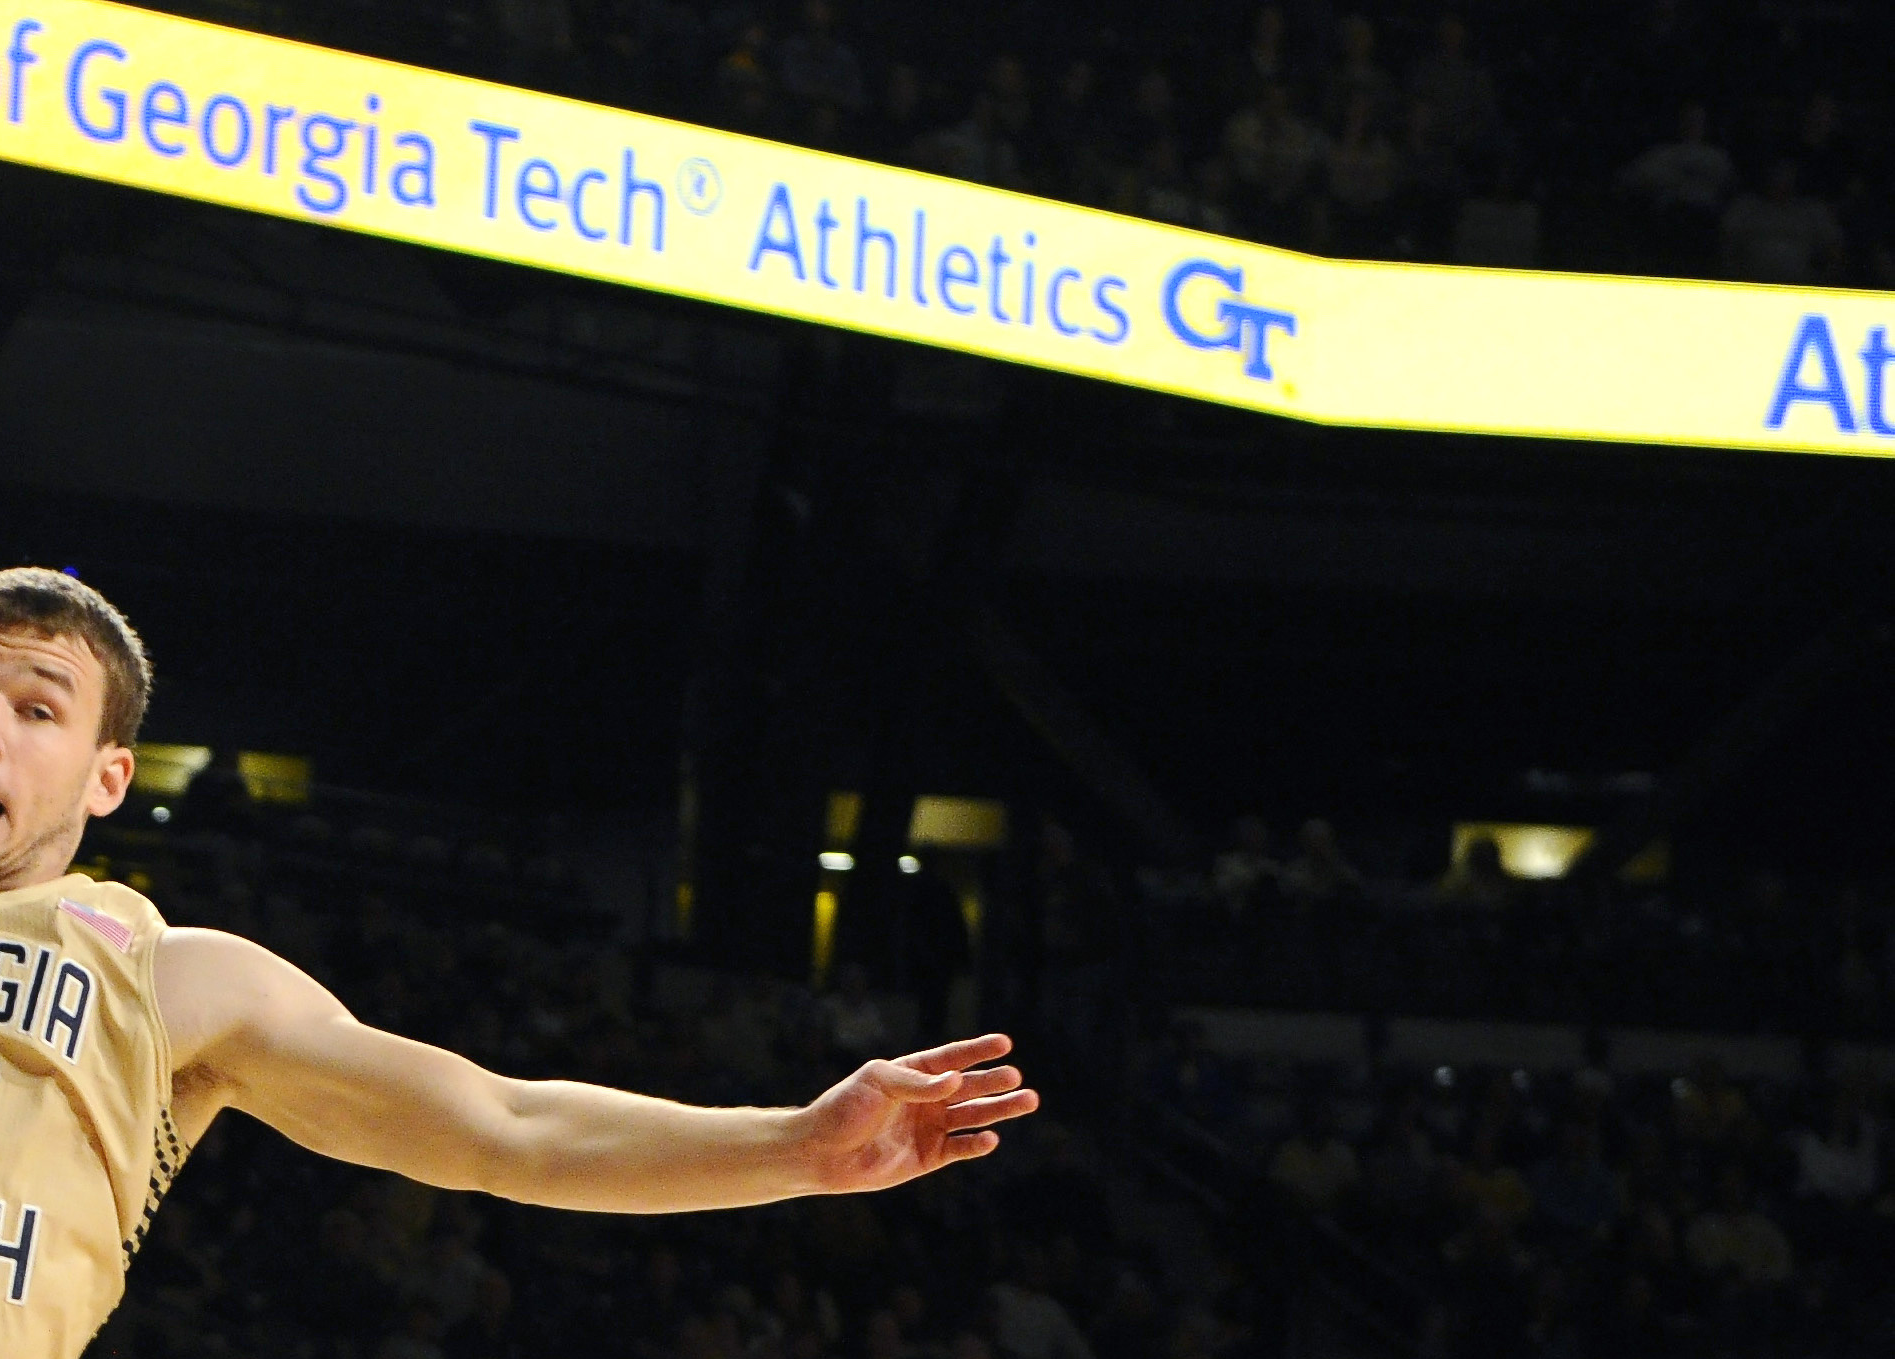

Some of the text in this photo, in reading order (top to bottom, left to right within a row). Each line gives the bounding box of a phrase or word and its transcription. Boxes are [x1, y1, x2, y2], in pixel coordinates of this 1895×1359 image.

[64, 38, 438, 216] Georgia
[747, 181, 1132, 346] Athletics
[1159, 257, 1299, 383] GT
